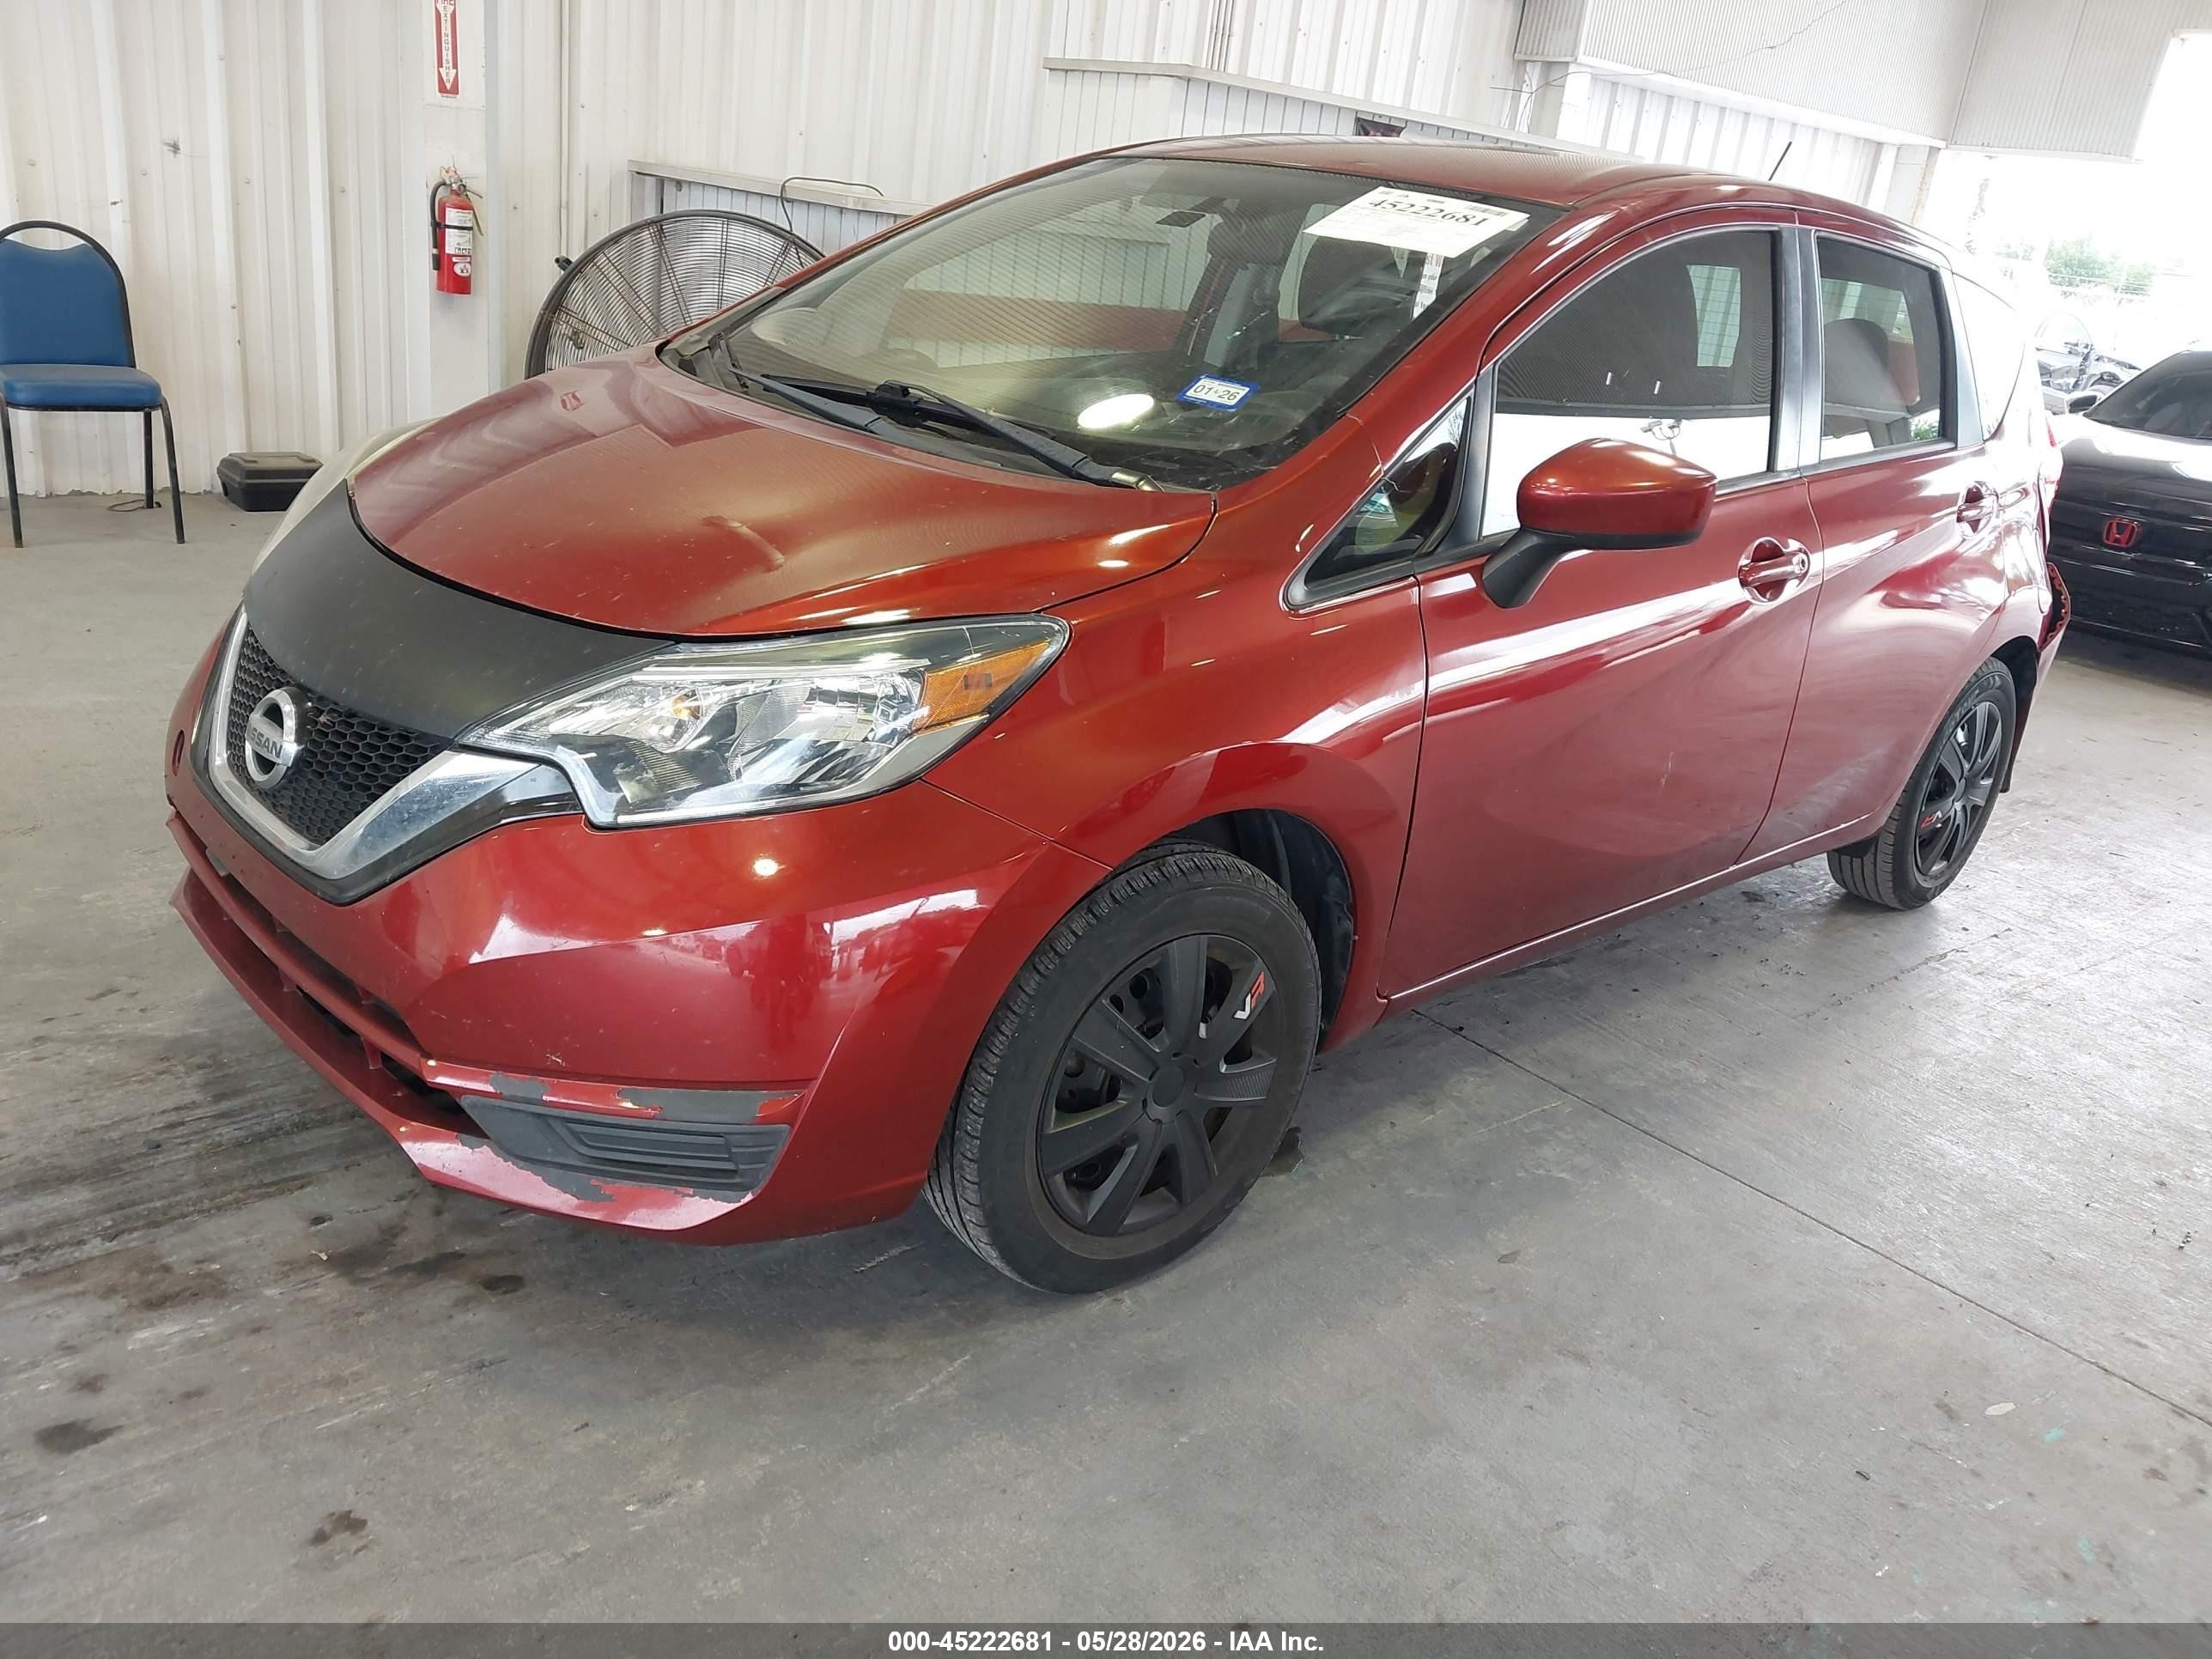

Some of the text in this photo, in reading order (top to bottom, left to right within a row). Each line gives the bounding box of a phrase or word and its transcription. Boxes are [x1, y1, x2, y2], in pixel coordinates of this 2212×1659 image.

[1369, 198, 1489, 226] 45222681
[1193, 384, 1213, 396] 01
[1217, 389, 1240, 401] 26
[246, 726, 283, 758] SSAN
